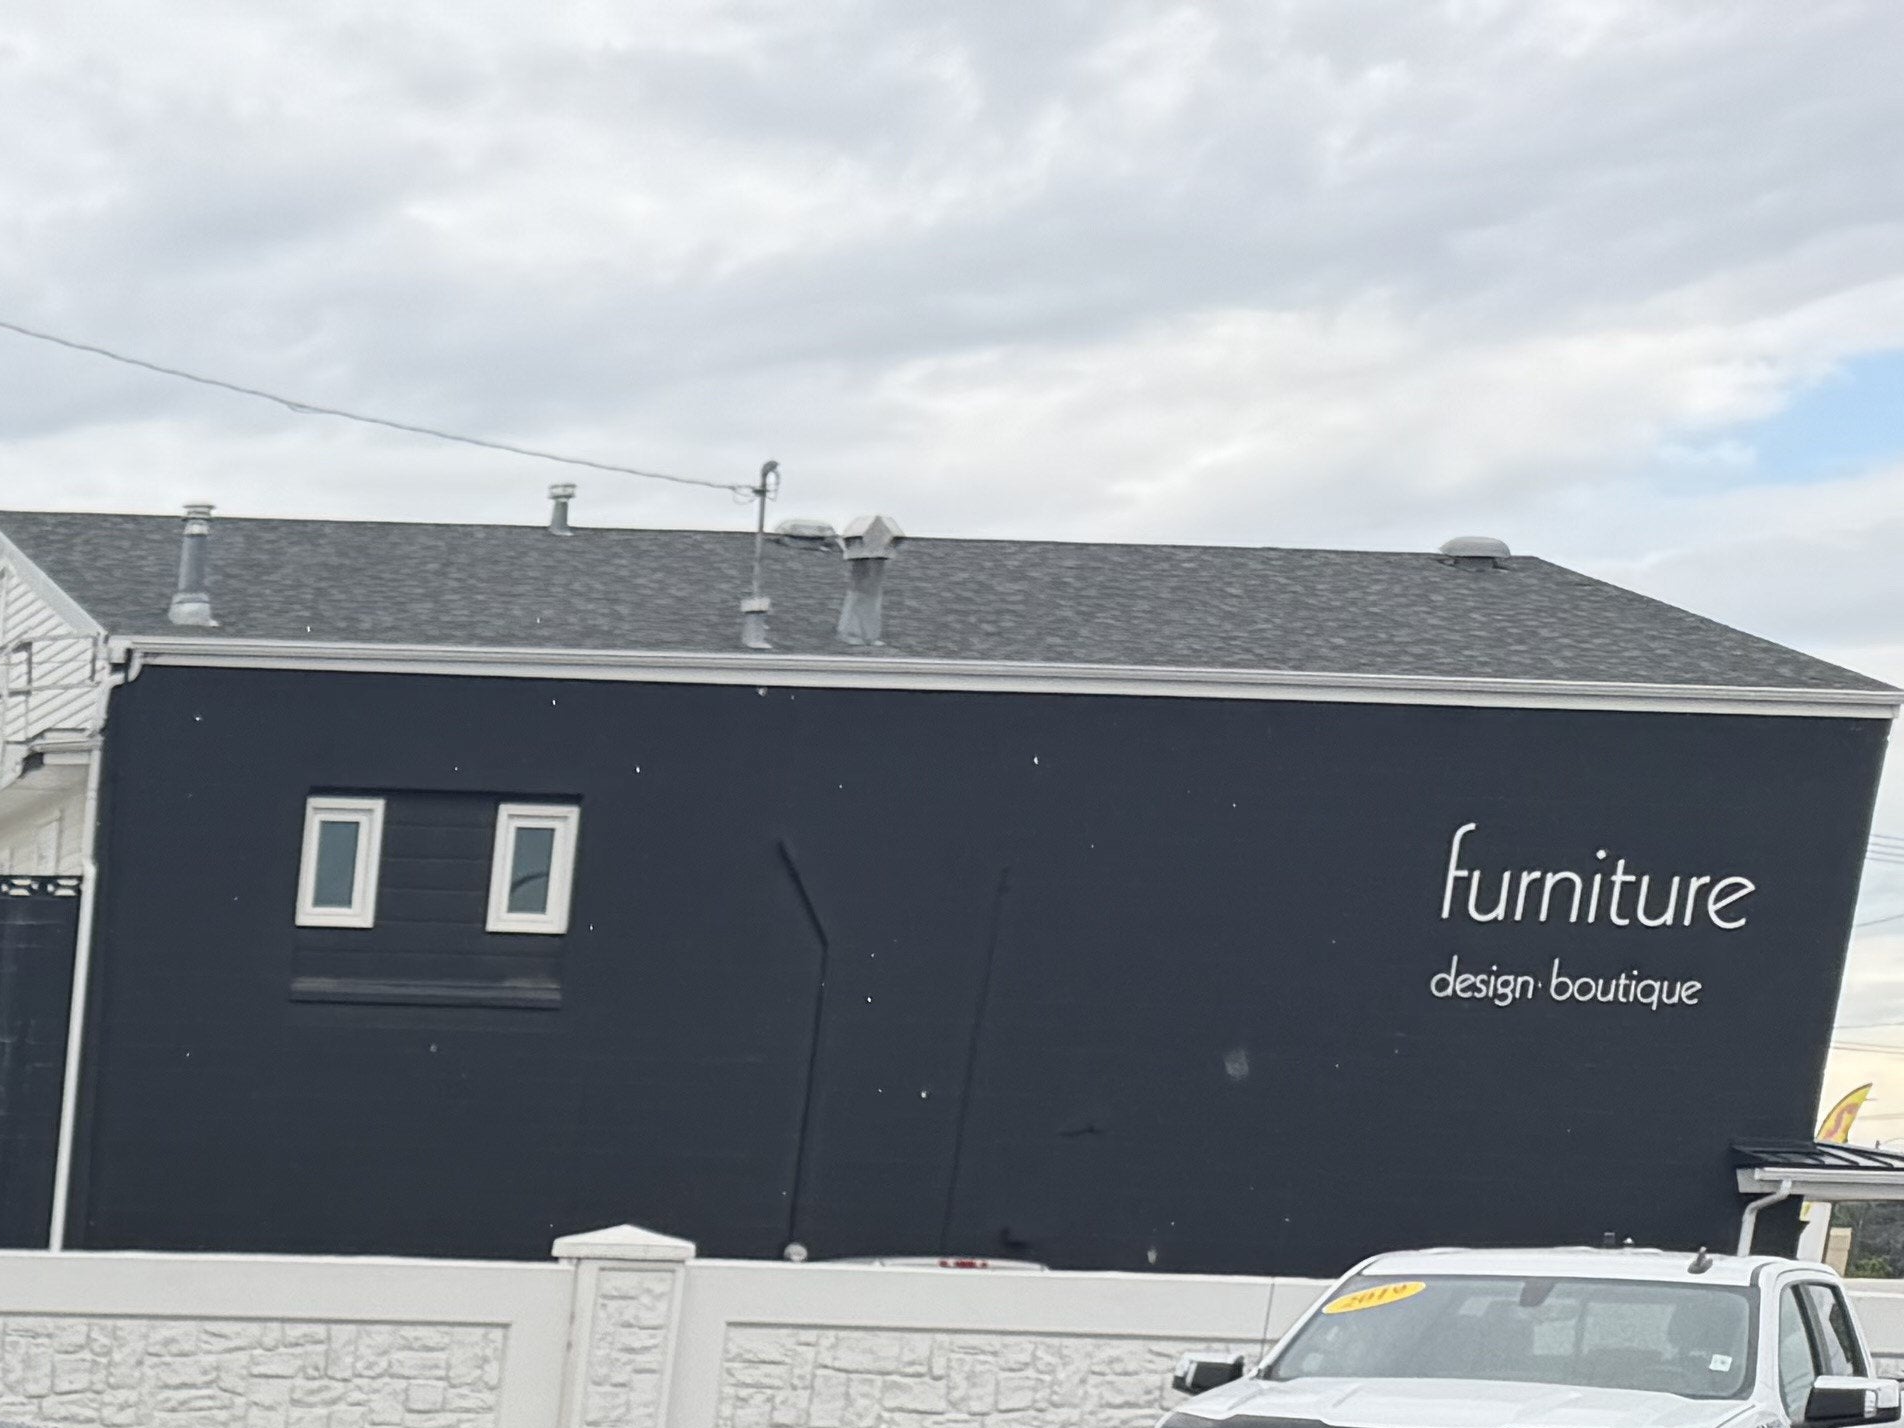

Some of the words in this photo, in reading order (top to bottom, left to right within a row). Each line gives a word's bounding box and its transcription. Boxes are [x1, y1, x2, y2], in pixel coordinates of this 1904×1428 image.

[1441, 822, 1756, 929] furniture
[1430, 954, 1534, 1007] design
[1548, 957, 1703, 1011] boutique
